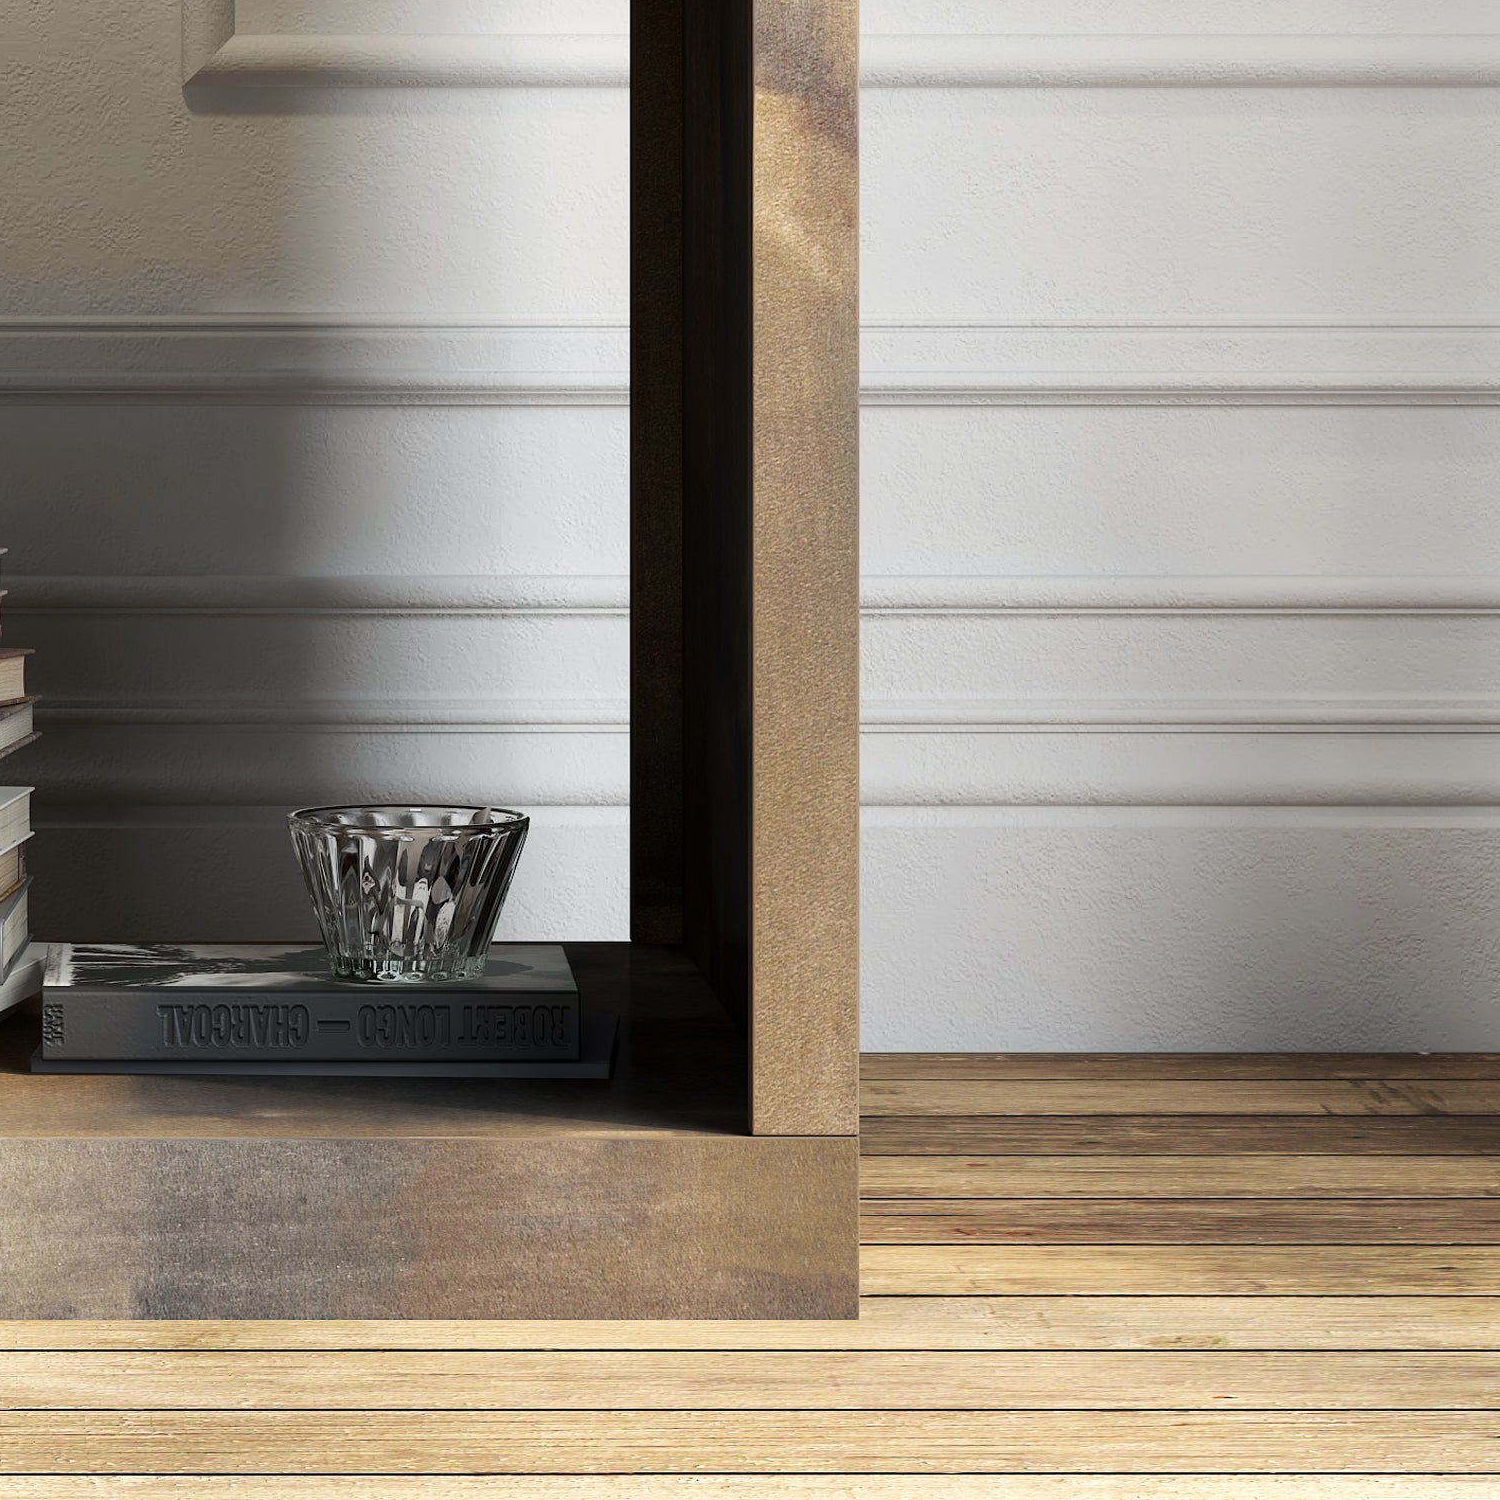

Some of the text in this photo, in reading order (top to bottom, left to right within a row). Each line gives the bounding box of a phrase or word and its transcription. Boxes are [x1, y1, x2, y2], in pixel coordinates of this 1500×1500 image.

[156, 1003, 311, 1049] CHARCOAL
[357, 1003, 451, 1049] LONGO
[457, 1003, 573, 1048] ROBERT
